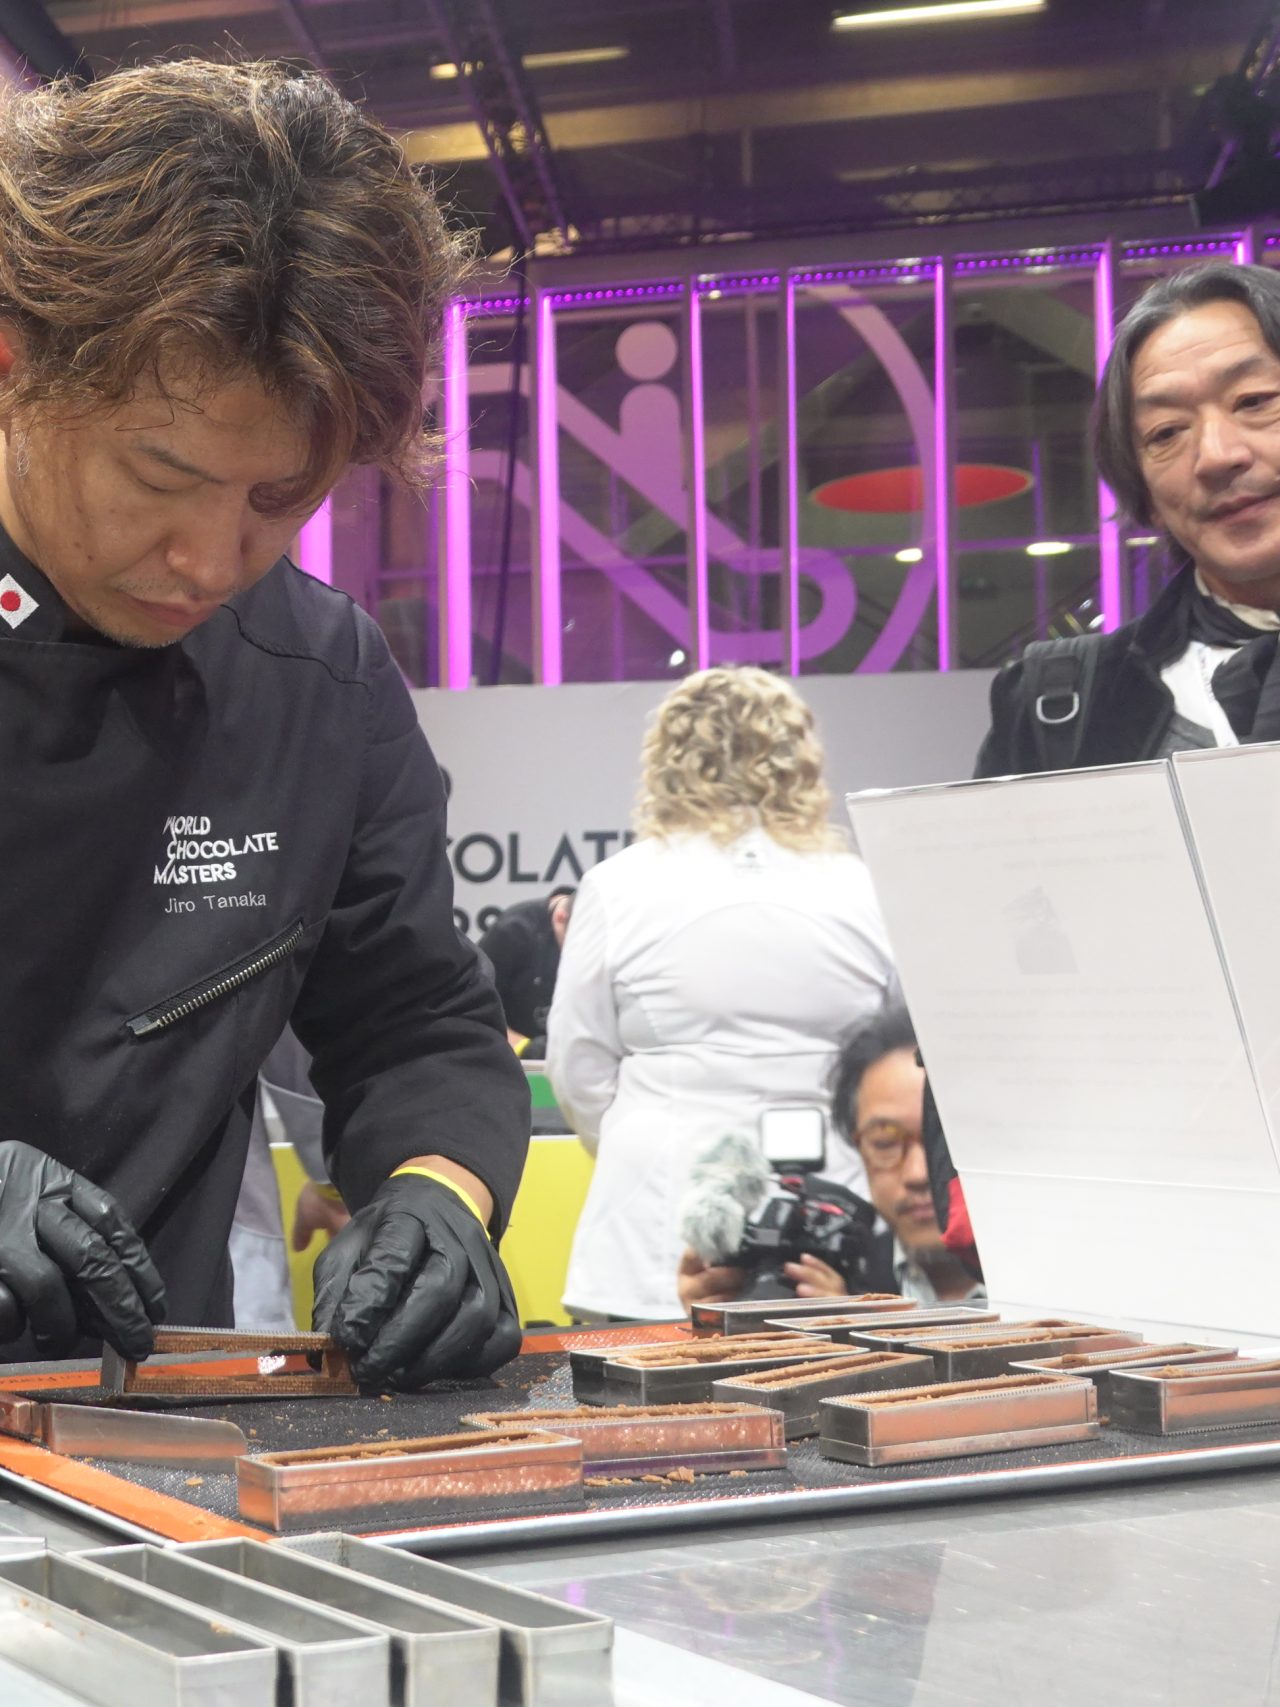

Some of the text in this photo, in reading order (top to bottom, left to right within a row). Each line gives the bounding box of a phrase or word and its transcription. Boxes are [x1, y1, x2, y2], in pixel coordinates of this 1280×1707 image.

[162, 815, 211, 844] WORLD
[167, 831, 279, 860] CHOCOLATE
[447, 831, 634, 884] OLAT
[153, 861, 237, 885] MASTERS
[165, 891, 267, 913] Jiro Tanaka
